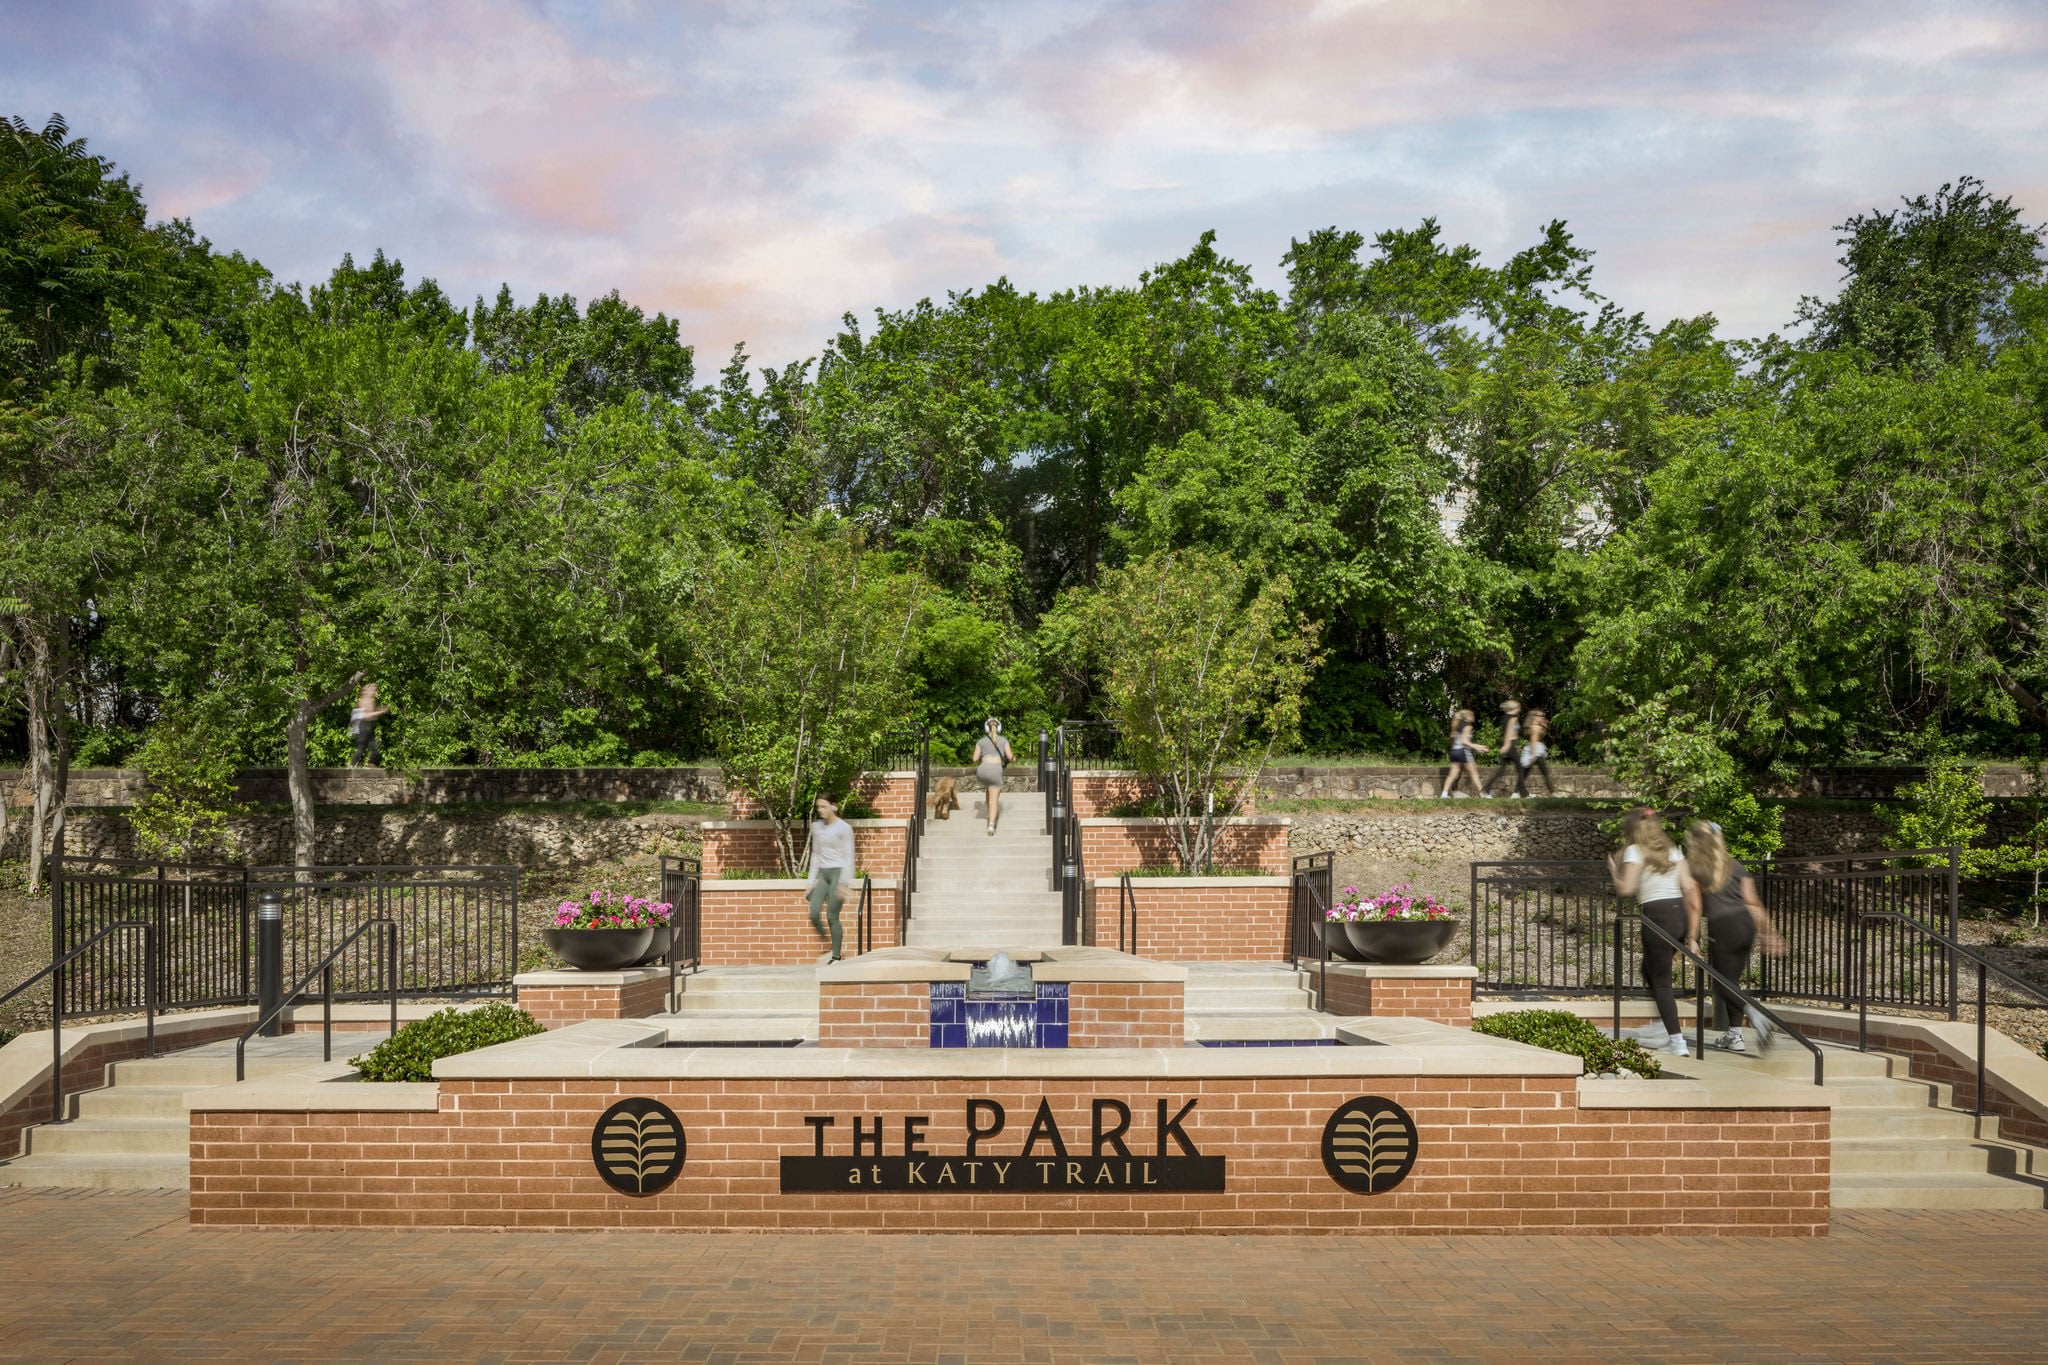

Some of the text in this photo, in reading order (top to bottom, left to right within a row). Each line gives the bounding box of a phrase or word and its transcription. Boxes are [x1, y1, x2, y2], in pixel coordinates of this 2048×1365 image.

[804, 1096, 1200, 1157] THE PARK
[848, 1162, 1158, 1185] at KATY TRAIL
